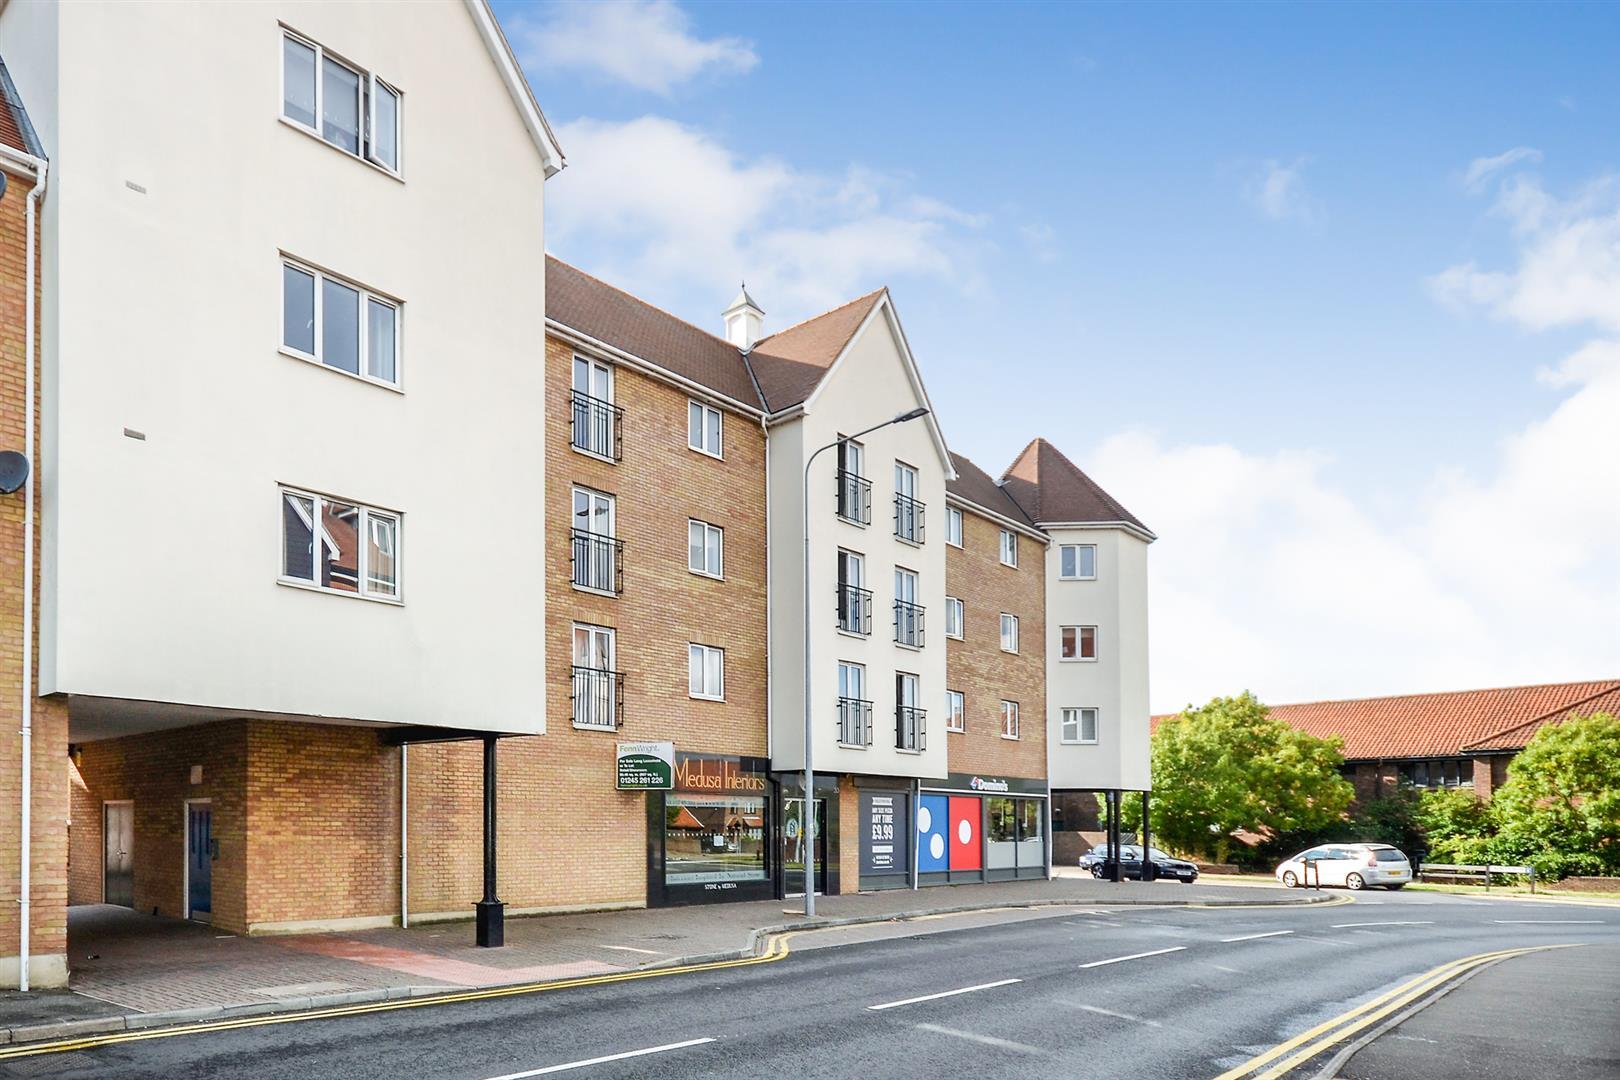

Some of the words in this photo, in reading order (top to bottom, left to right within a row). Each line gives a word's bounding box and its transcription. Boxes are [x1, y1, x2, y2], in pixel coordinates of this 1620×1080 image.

[674, 757, 722, 789] Medusa
[724, 760, 765, 791] Interiors
[872, 824, 893, 840] £9.99
